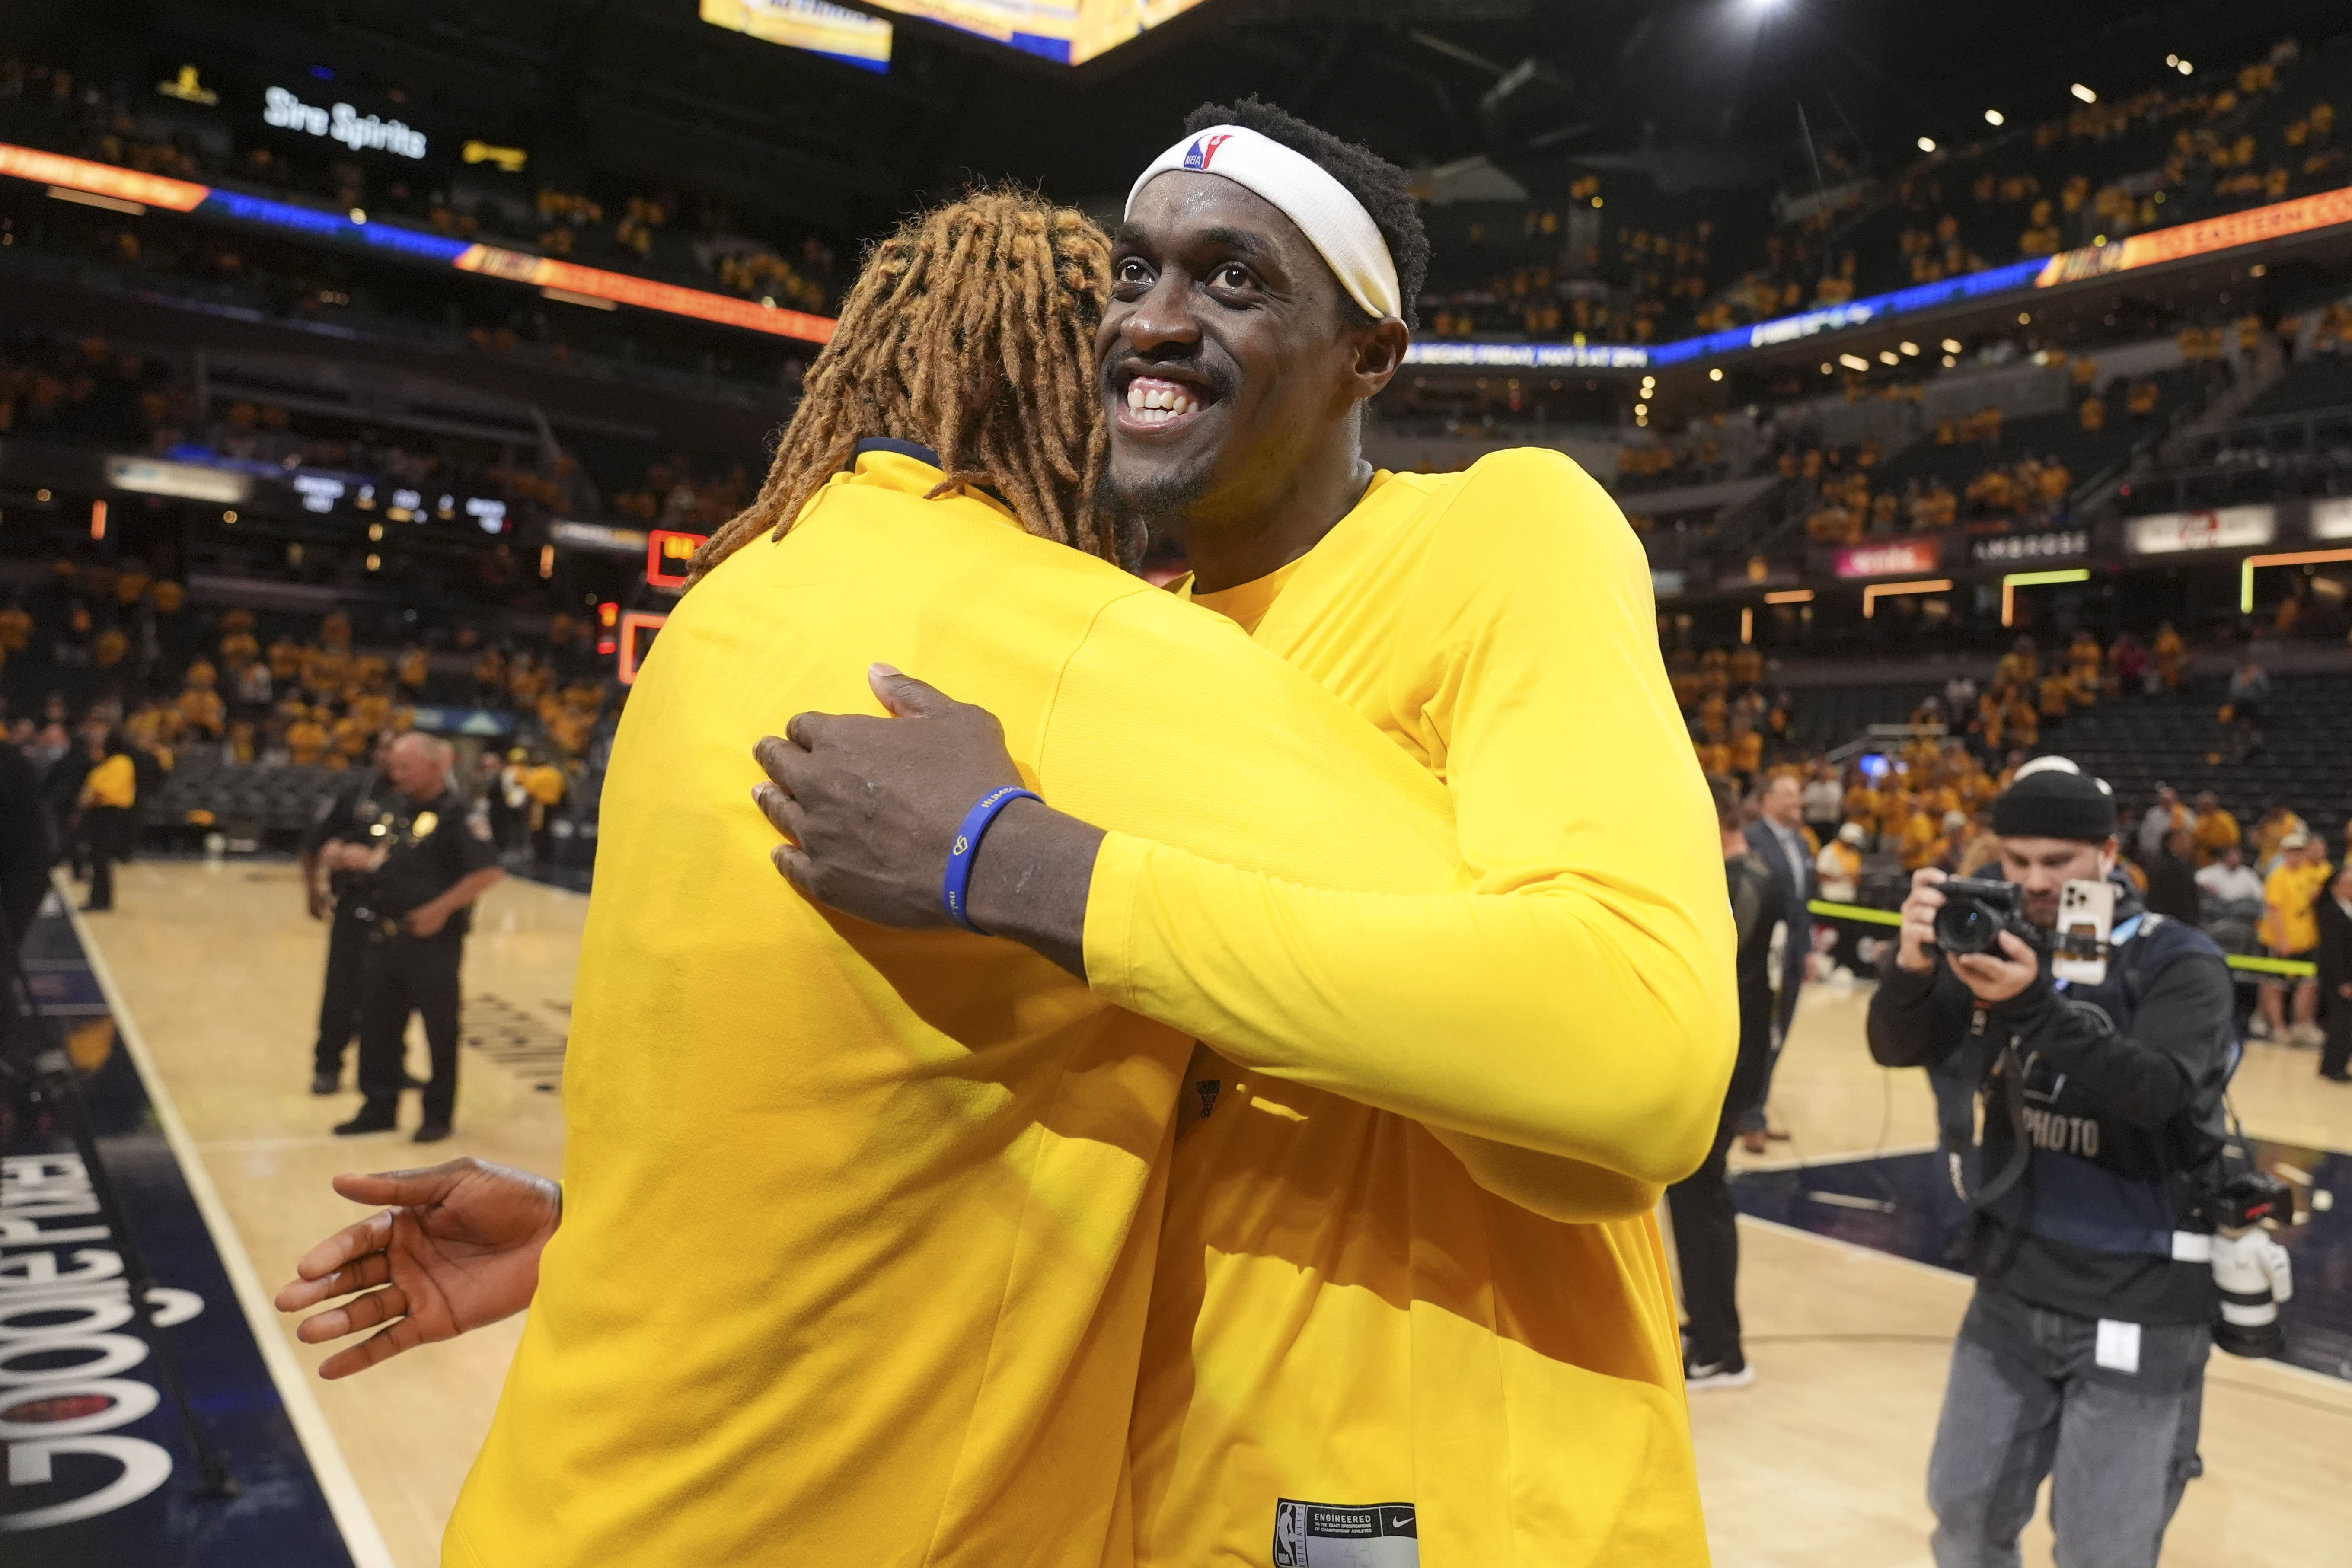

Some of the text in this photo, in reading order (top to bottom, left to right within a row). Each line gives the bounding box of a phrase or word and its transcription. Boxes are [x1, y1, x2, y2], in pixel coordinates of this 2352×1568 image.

[1185, 155, 1201, 165] NBA
[2192, 209, 2306, 248] EASTERN
[2022, 1106, 2100, 1158] PHOTO
[0, 1152, 205, 1531] Google Pixel
[1296, 1505, 1306, 1568] AUTHENTICS
[1314, 1513, 1371, 1523] ENGINEERED
